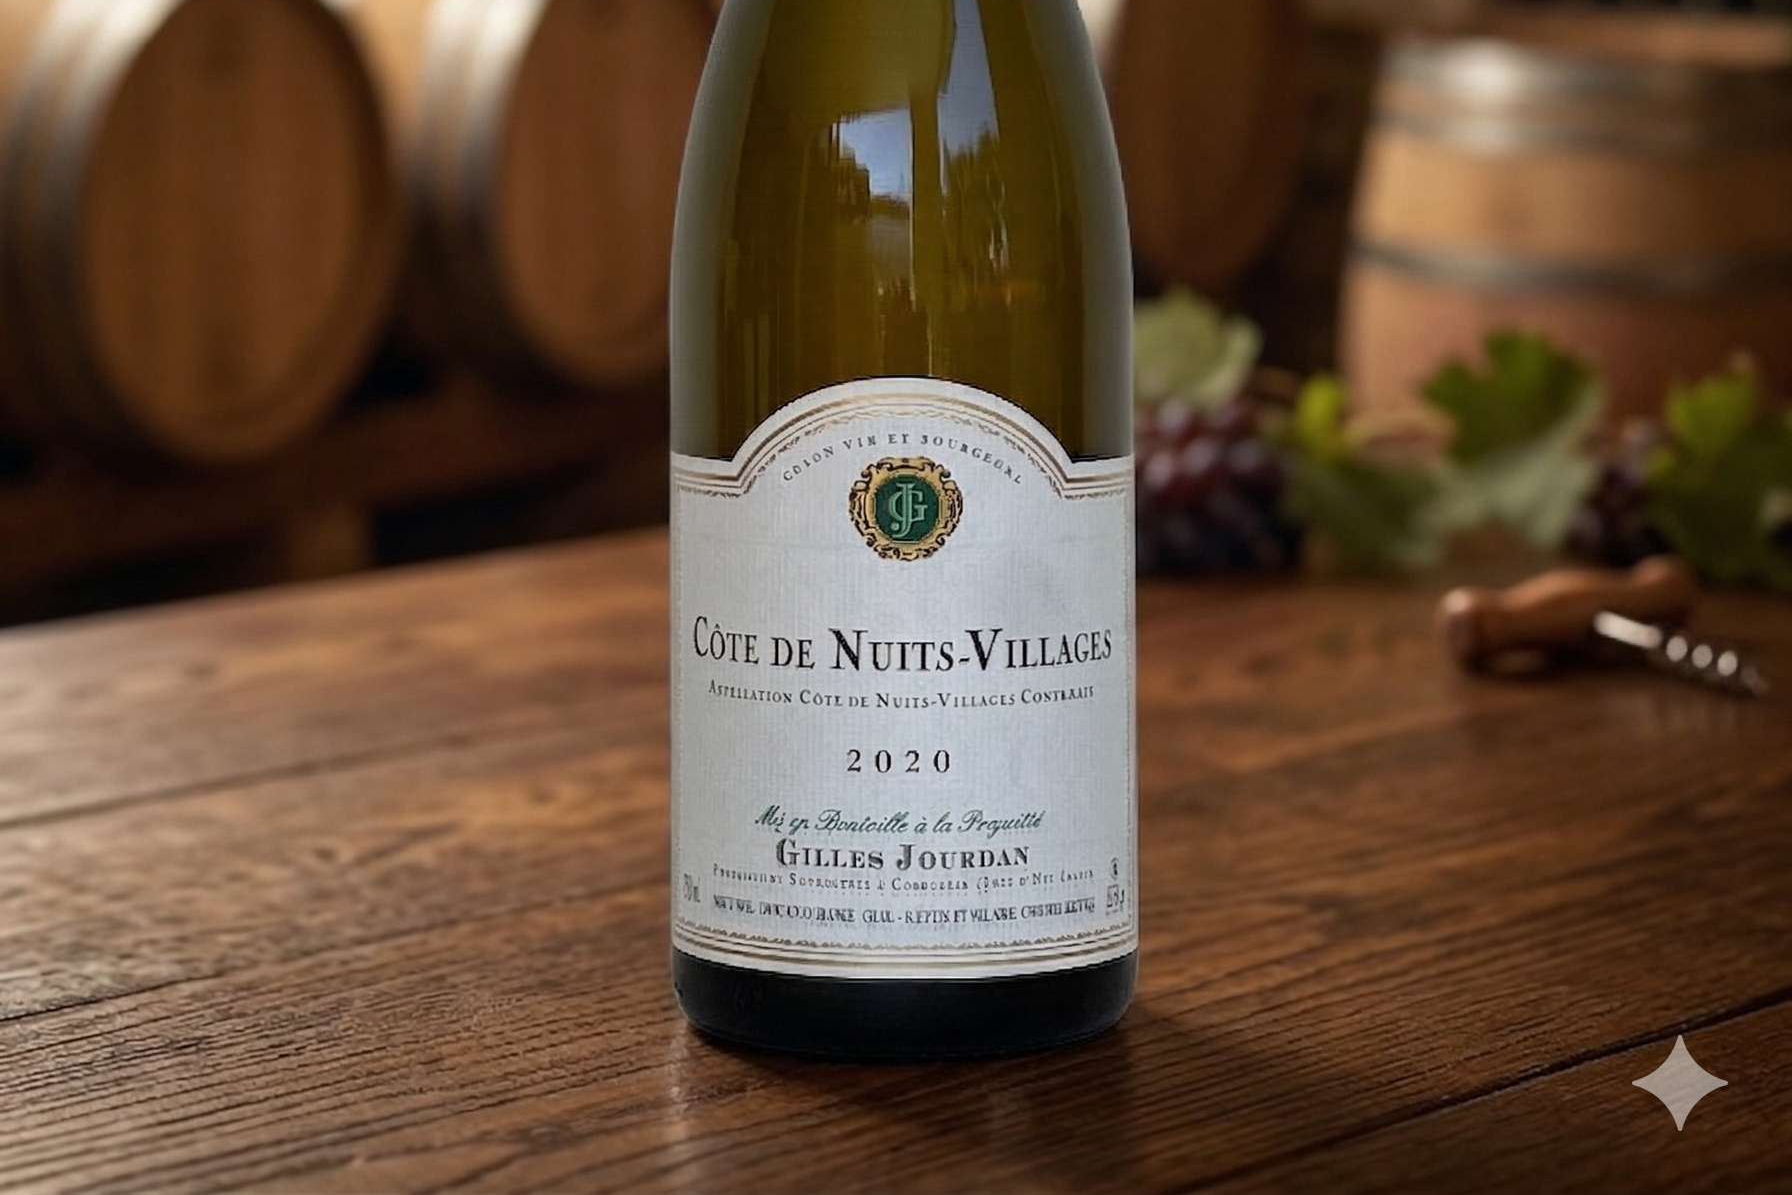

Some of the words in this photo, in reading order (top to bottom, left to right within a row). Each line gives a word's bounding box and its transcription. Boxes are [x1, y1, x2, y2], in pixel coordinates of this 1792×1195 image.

[693, 615, 760, 665] CÔTE
[770, 637, 816, 670] DE
[828, 627, 1113, 672] NUITS-VILLAGES
[848, 695, 870, 708] DE
[846, 748, 952, 774] 2020
[931, 810, 953, 835] la
[775, 837, 885, 871] GILLES
[896, 842, 1031, 871] JOURDAN
